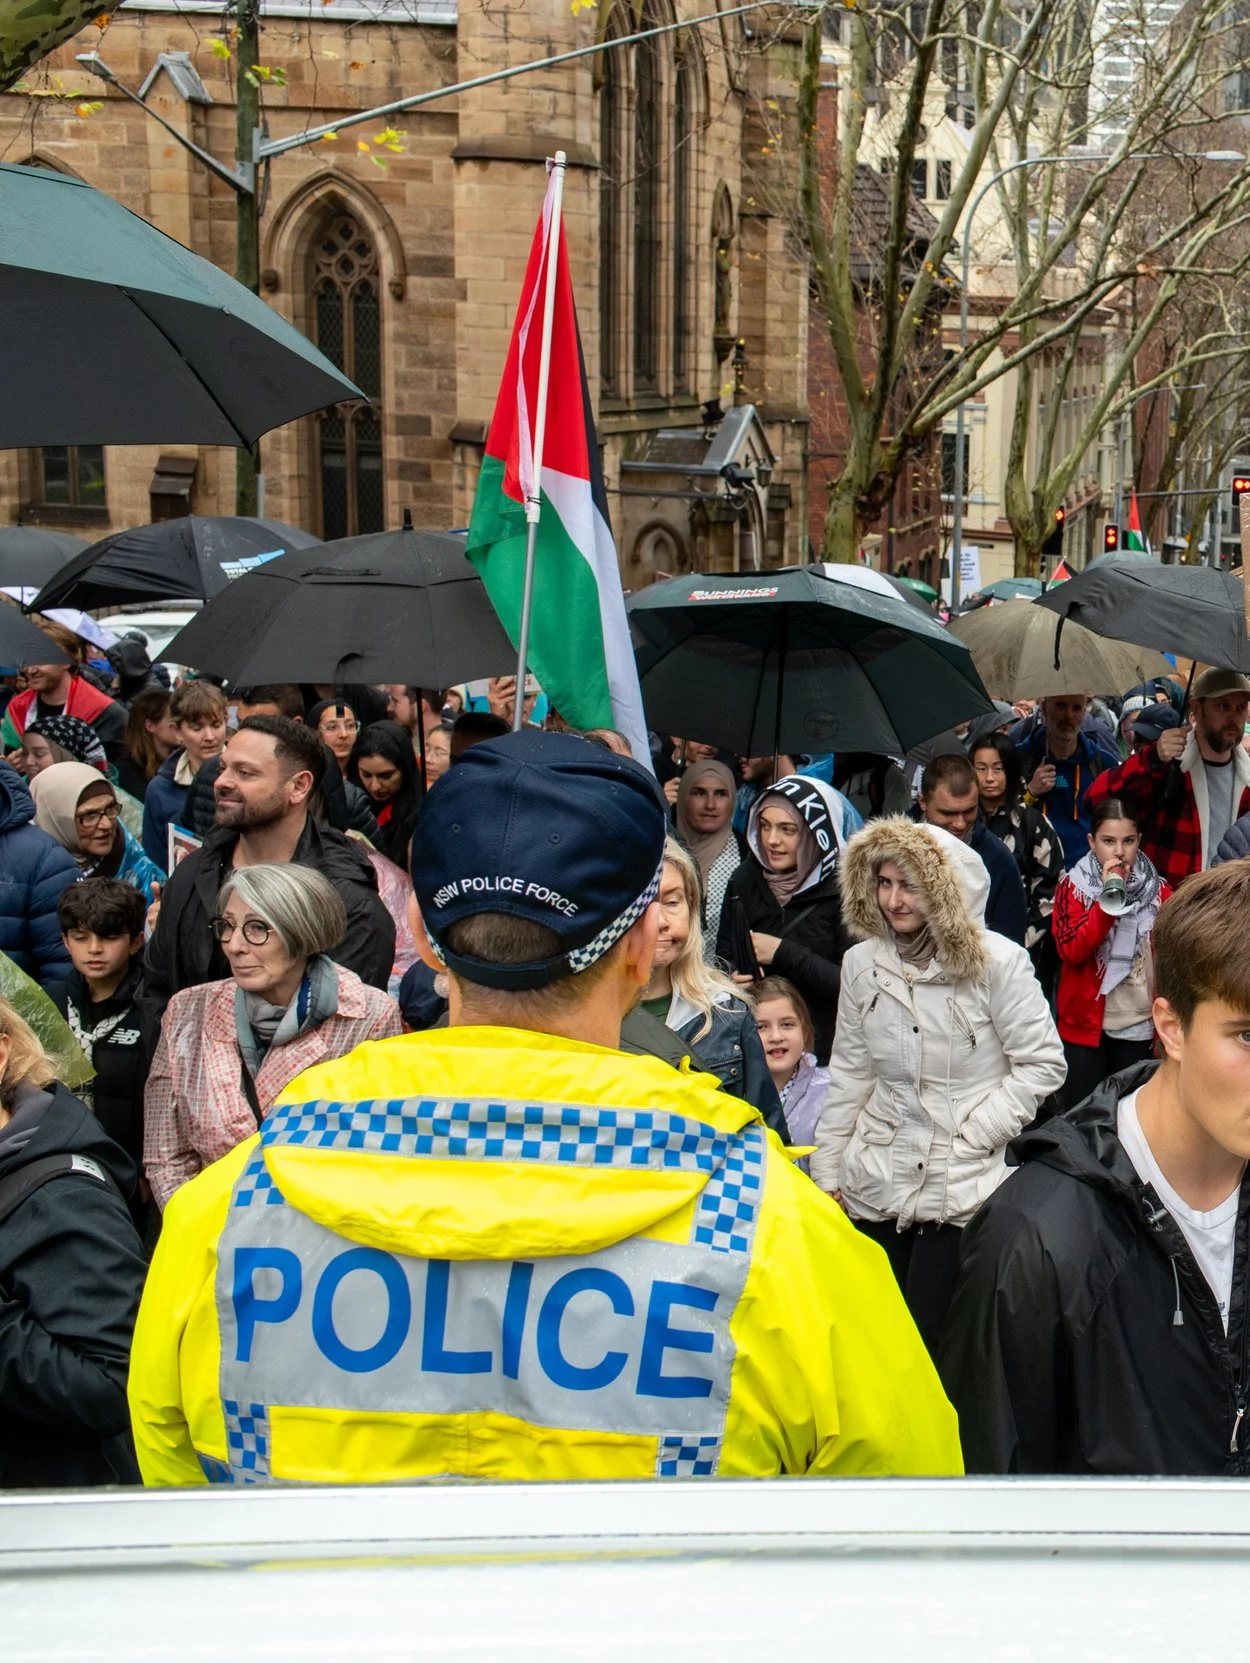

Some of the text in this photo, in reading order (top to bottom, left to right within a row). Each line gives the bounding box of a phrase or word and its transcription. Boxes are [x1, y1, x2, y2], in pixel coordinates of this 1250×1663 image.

[692, 587, 779, 597] BUNNINGS
[796, 792, 838, 882] Klein
[432, 876, 579, 918] NSW POLICE FORCE
[232, 1247, 720, 1398] POLICE
